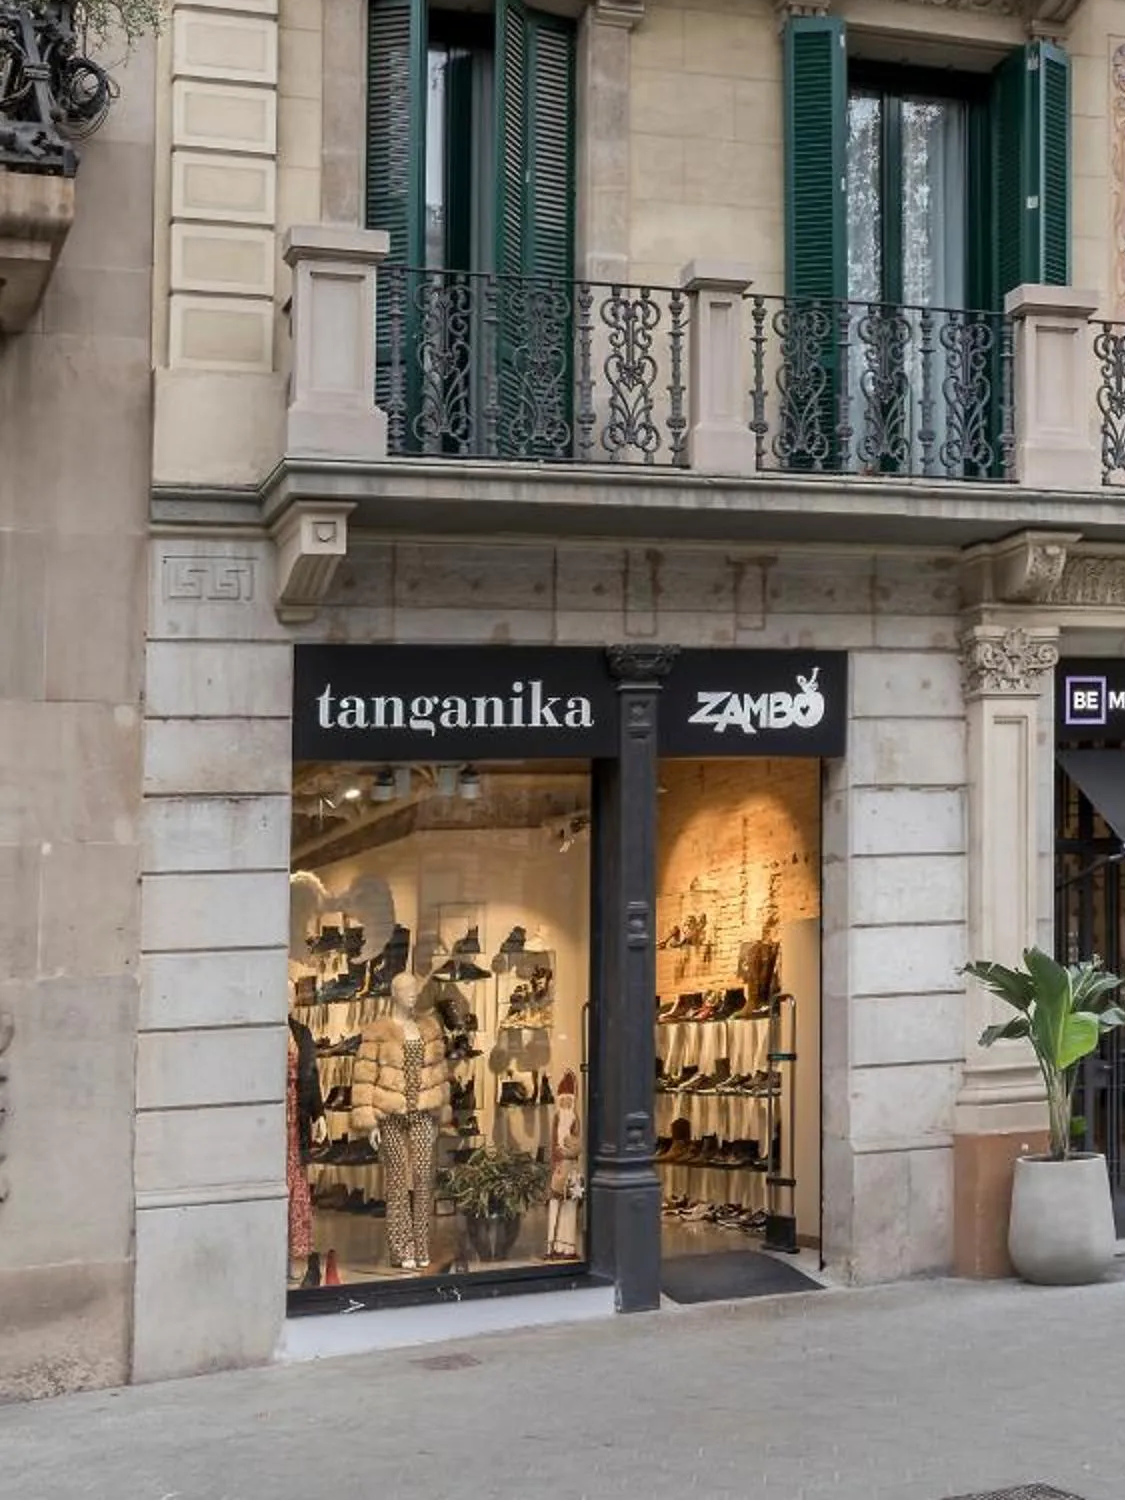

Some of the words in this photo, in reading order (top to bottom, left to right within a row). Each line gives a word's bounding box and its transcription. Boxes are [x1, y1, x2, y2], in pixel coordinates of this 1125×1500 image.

[316, 680, 595, 737] tanganika
[687, 688, 825, 734] ZAMBO
[1072, 691, 1099, 710] BE
